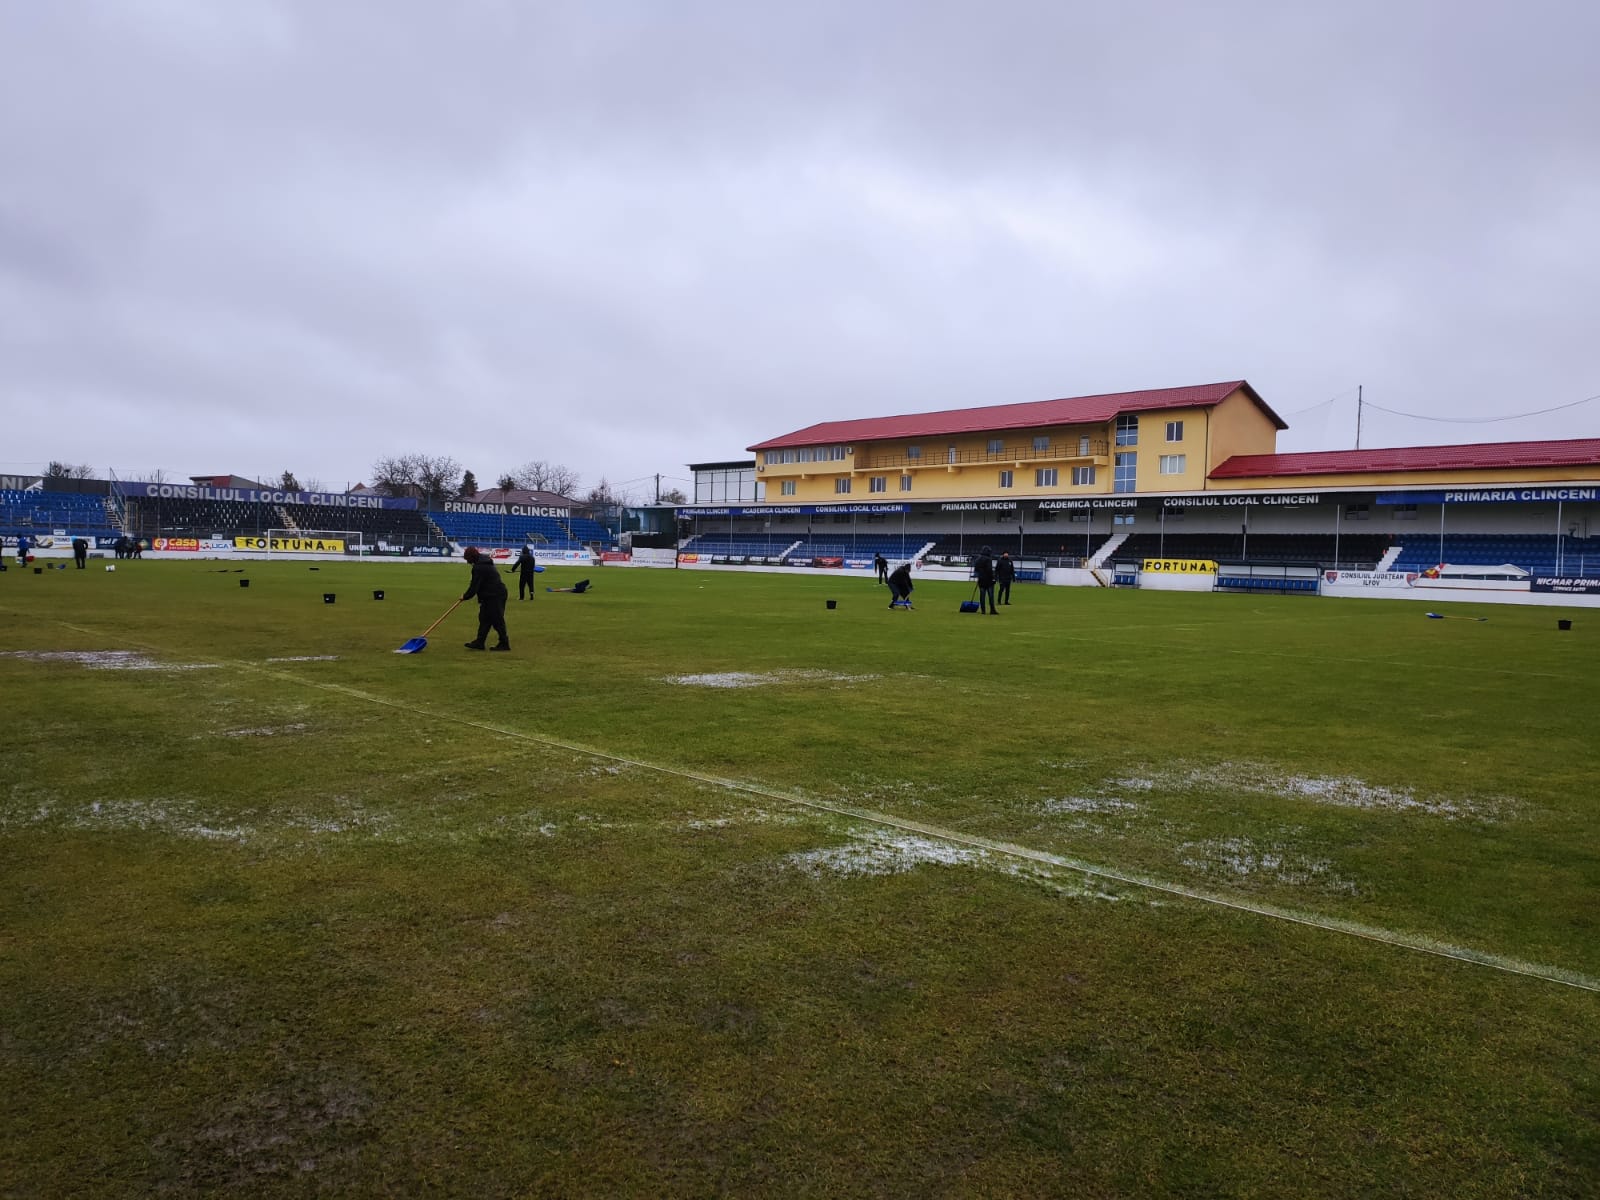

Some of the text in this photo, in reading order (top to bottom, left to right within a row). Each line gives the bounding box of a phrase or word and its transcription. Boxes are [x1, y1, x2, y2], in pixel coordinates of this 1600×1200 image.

[146, 485, 383, 509] CONSILIUL LOCAL CLINCENI
[1163, 495, 1319, 507] CONSILIUL LOCAL CLINCENI
[1444, 489, 1596, 502] PRIMARIA CLINCENI
[444, 502, 569, 517] PRIMARIA CLINCENI
[849, 505, 870, 513] LOCAL
[871, 504, 903, 513] CLINCENI
[941, 502, 1017, 512] PRIMARIA CLINCENI
[1038, 499, 1138, 510] ACADEMICA CLINCENI
[169, 538, 197, 547] casa
[1536, 578, 1573, 586] NICMAR
